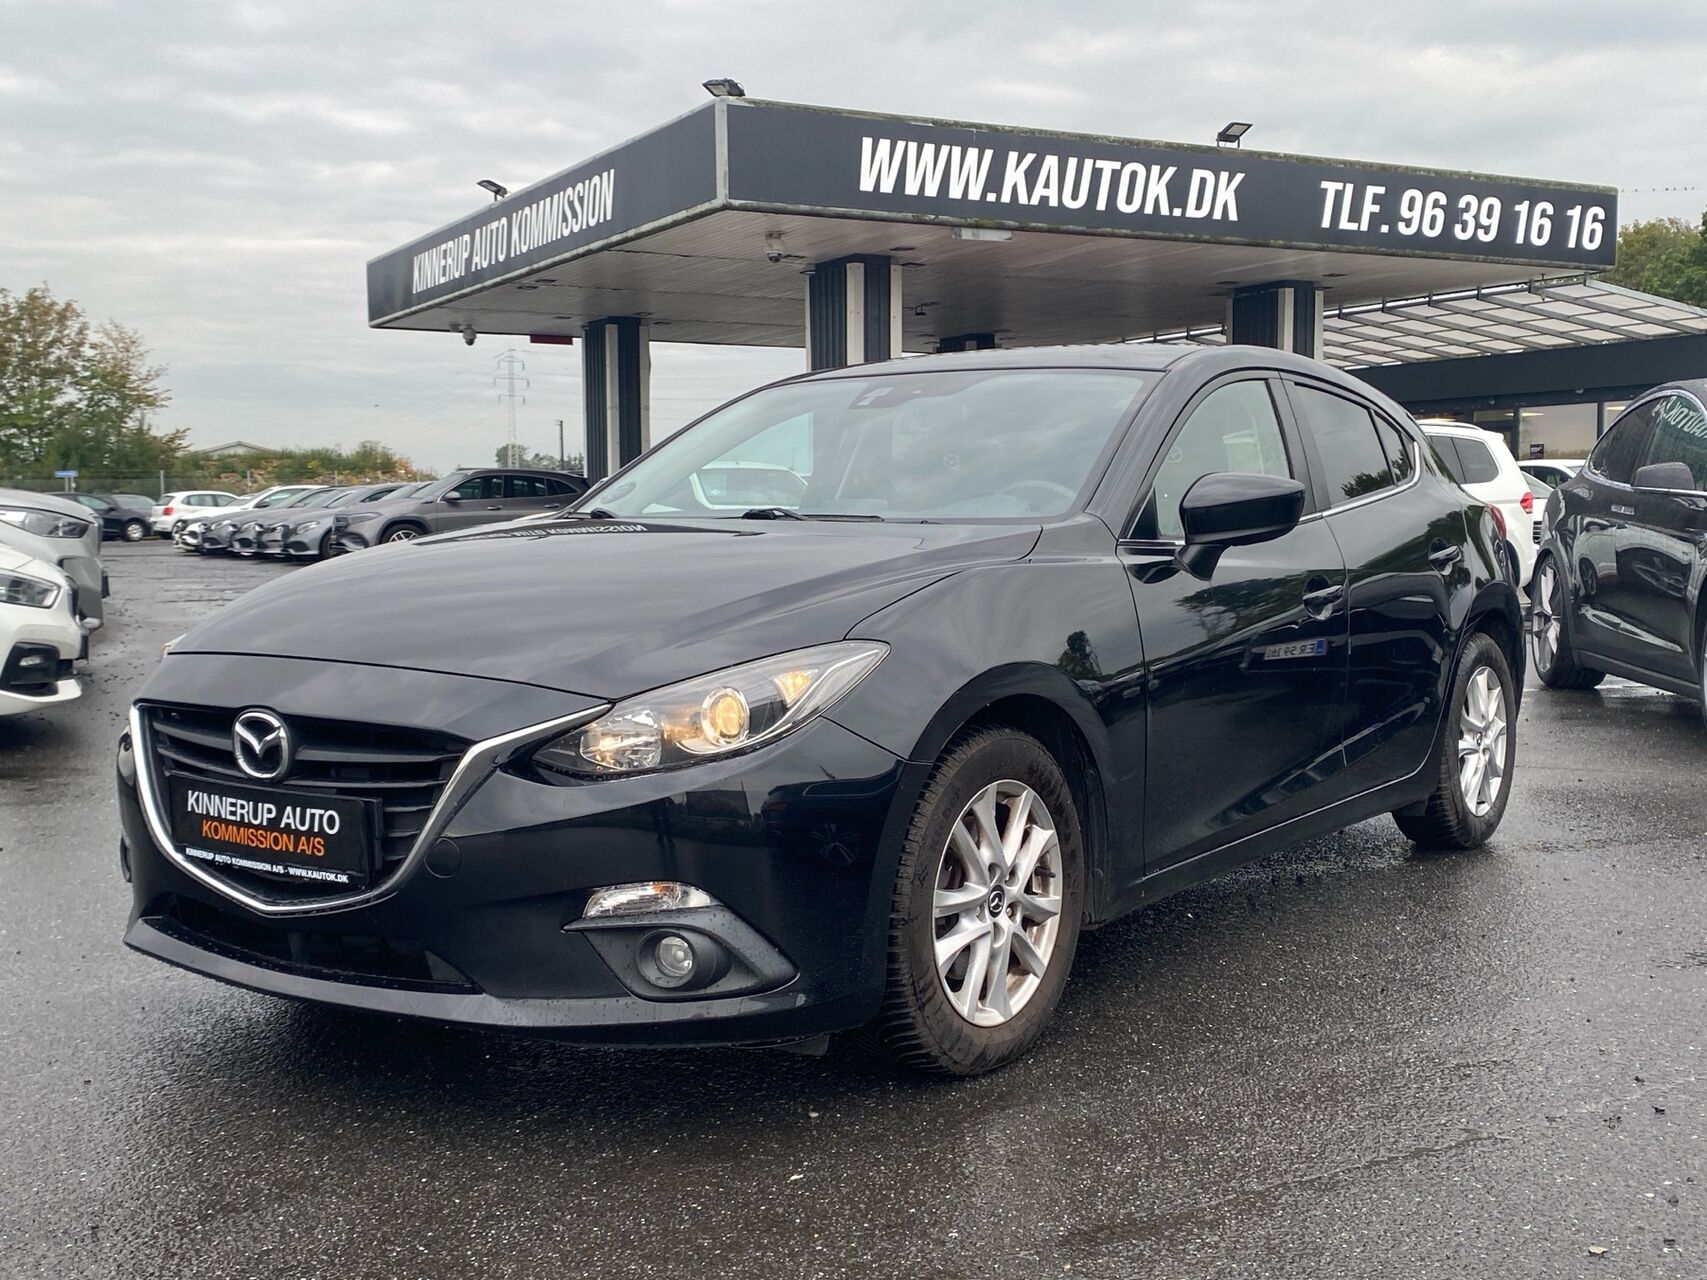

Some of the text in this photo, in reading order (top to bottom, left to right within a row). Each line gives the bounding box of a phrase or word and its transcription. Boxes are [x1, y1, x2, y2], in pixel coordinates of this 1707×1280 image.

[859, 136, 1606, 251] WWW.KAUTOK.DK TLF. 96 39 16 16
[413, 168, 615, 294] KINNERUP AUTO KOMMISSION
[186, 790, 340, 835] KINNERUP AUTO
[202, 819, 325, 857] KOMMISSION A/S
[185, 847, 215, 861] KINNERUP
[215, 854, 231, 865] AUTO
[231, 856, 272, 872] KOMMISSION
[287, 867, 349, 883] WWW.KAUTOK.DK
